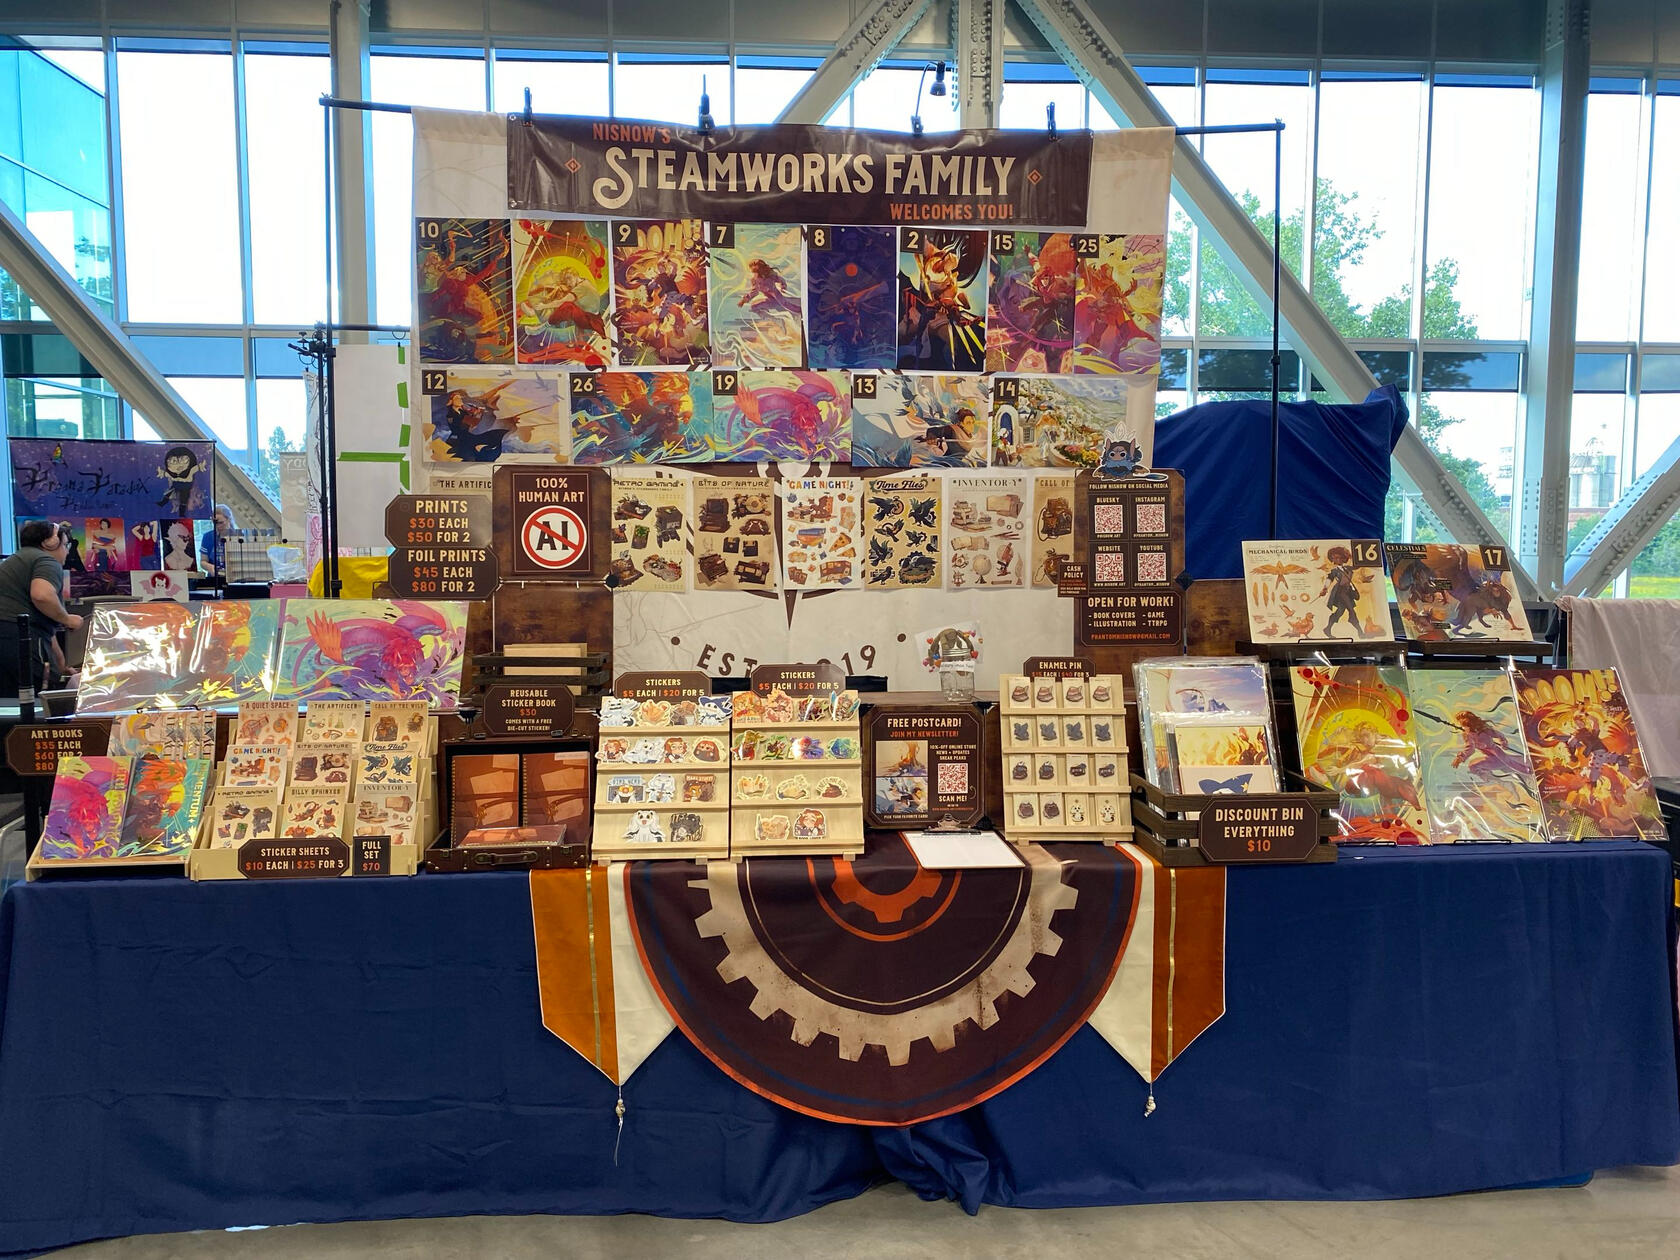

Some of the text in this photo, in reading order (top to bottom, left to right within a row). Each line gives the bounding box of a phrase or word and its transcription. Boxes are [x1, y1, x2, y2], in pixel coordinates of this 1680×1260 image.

[593, 122, 671, 144] NISNOW'S
[593, 147, 1016, 209] STEAMWORKS FAMILY
[890, 202, 1014, 221] WELCOMES YOU!
[418, 222, 439, 239] 10
[619, 225, 630, 242] 9
[716, 226, 728, 244] 7
[814, 229, 826, 247] 8
[908, 231, 919, 249] 2
[994, 234, 1013, 251] 15
[1079, 239, 1097, 253] 25
[424, 374, 444, 389] 12
[573, 378, 593, 392] 26
[717, 374, 735, 390] 19
[857, 377, 874, 393] 13
[998, 382, 1016, 398] 14
[440, 479, 456, 489] THE
[535, 477, 568, 488] 100%
[789, 480, 817, 489] GAME
[876, 479, 924, 490] Time Flies
[1040, 479, 1060, 487] CALL
[519, 490, 585, 503] HUMAN ART
[415, 500, 468, 514] PRINTS
[409, 517, 469, 529] $30 EACH
[407, 531, 470, 543] $50 FOR 2
[536, 520, 569, 551] AI
[408, 549, 486, 562] FOIL PRINTS
[1248, 548, 1288, 556] MECHANICAL
[1354, 543, 1378, 563] 16
[1484, 548, 1502, 566] 17
[414, 566, 473, 578] $45 EACH
[412, 581, 475, 593] $80 FOR 2
[1088, 596, 1174, 608] OPEN FOR WORK!
[1039, 661, 1082, 669] ENAMEL PIN
[781, 671, 816, 679] STICKERS
[646, 678, 682, 686] STICKERS
[759, 681, 840, 690] $5 EACH $20 FOR 5
[510, 689, 548, 697] REUSABLE
[663, 689, 680, 697] $20
[699, 688, 705, 696] 5
[251, 701, 269, 709] QUIET
[501, 699, 556, 707] STICKER BOOK
[887, 717, 962, 728] FREE POSTCARD!
[32, 729, 83, 739] ART BOOKS
[917, 730, 959, 738] NEWSLETTER!
[35, 741, 81, 750] $35 EACH
[233, 747, 254, 755] GAME
[368, 743, 386, 751] Time
[35, 752, 55, 760] $60
[35, 762, 55, 771] $80
[1215, 807, 1303, 822] DISCOUNT BIN
[1224, 825, 1295, 838] EVERYTHING
[362, 841, 381, 850] FULL
[1247, 839, 1271, 852] $10
[260, 847, 330, 857] STICKER SHEETS
[364, 850, 380, 859] SET
[245, 859, 344, 870] $10 EACH $25 FOR 3
[362, 862, 380, 871] $70
